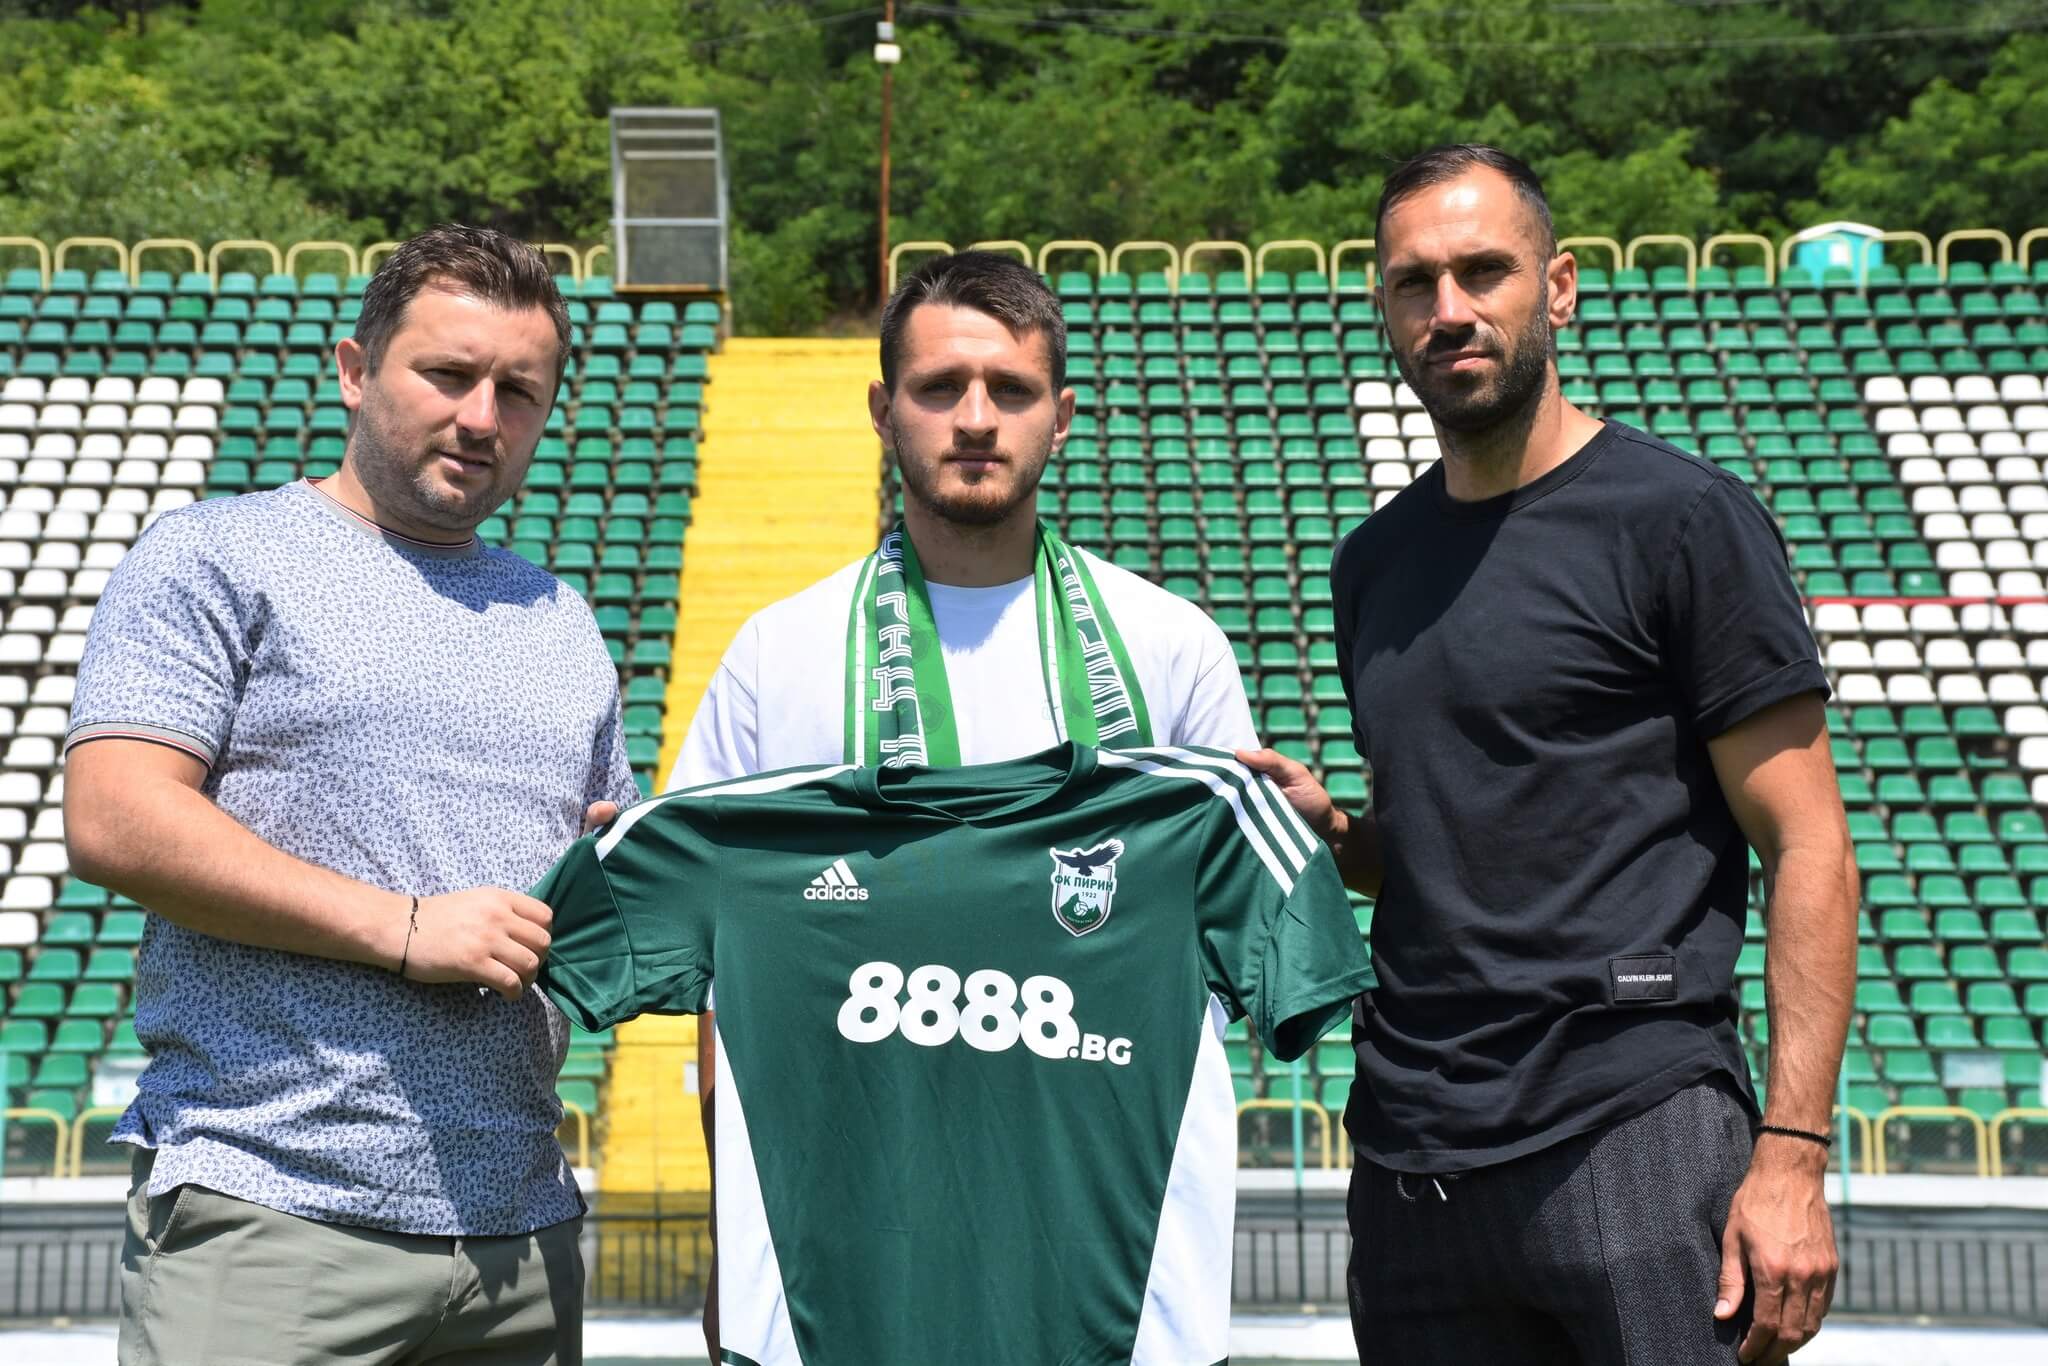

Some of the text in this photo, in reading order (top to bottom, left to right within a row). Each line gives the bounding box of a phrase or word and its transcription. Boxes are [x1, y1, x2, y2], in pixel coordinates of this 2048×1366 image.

[1054, 875, 1113, 891] ФК ПИРИН
[803, 884, 869, 901] adidas
[1617, 975, 1638, 983] CALVIN
